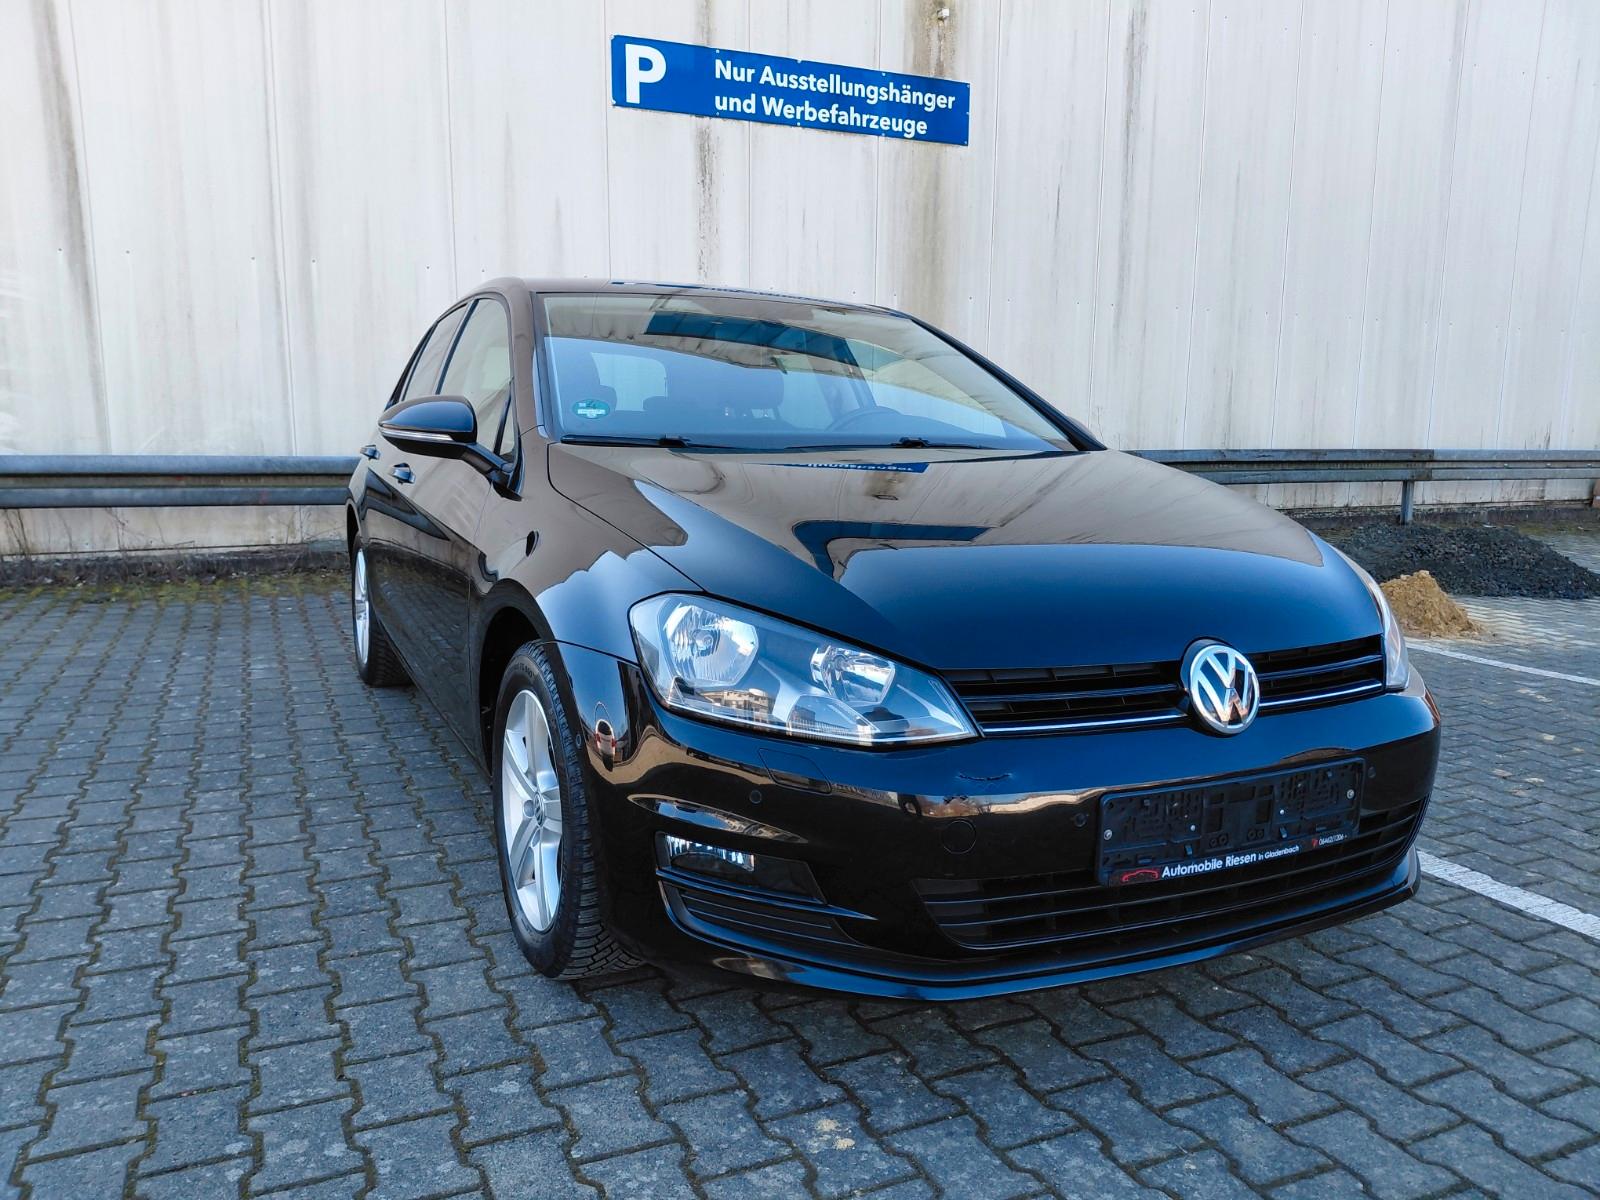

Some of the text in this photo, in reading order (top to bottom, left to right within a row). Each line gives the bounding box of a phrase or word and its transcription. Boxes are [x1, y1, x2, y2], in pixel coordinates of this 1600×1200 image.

[625, 44, 667, 104] P
[714, 59, 955, 111] Nur Ausstellungshänger
[714, 95, 928, 138] und Werbefahrzeuge
[1161, 857, 1223, 878] Automobile
[1225, 853, 1257, 867] Riesen
[1264, 845, 1299, 860] Gladenbach
